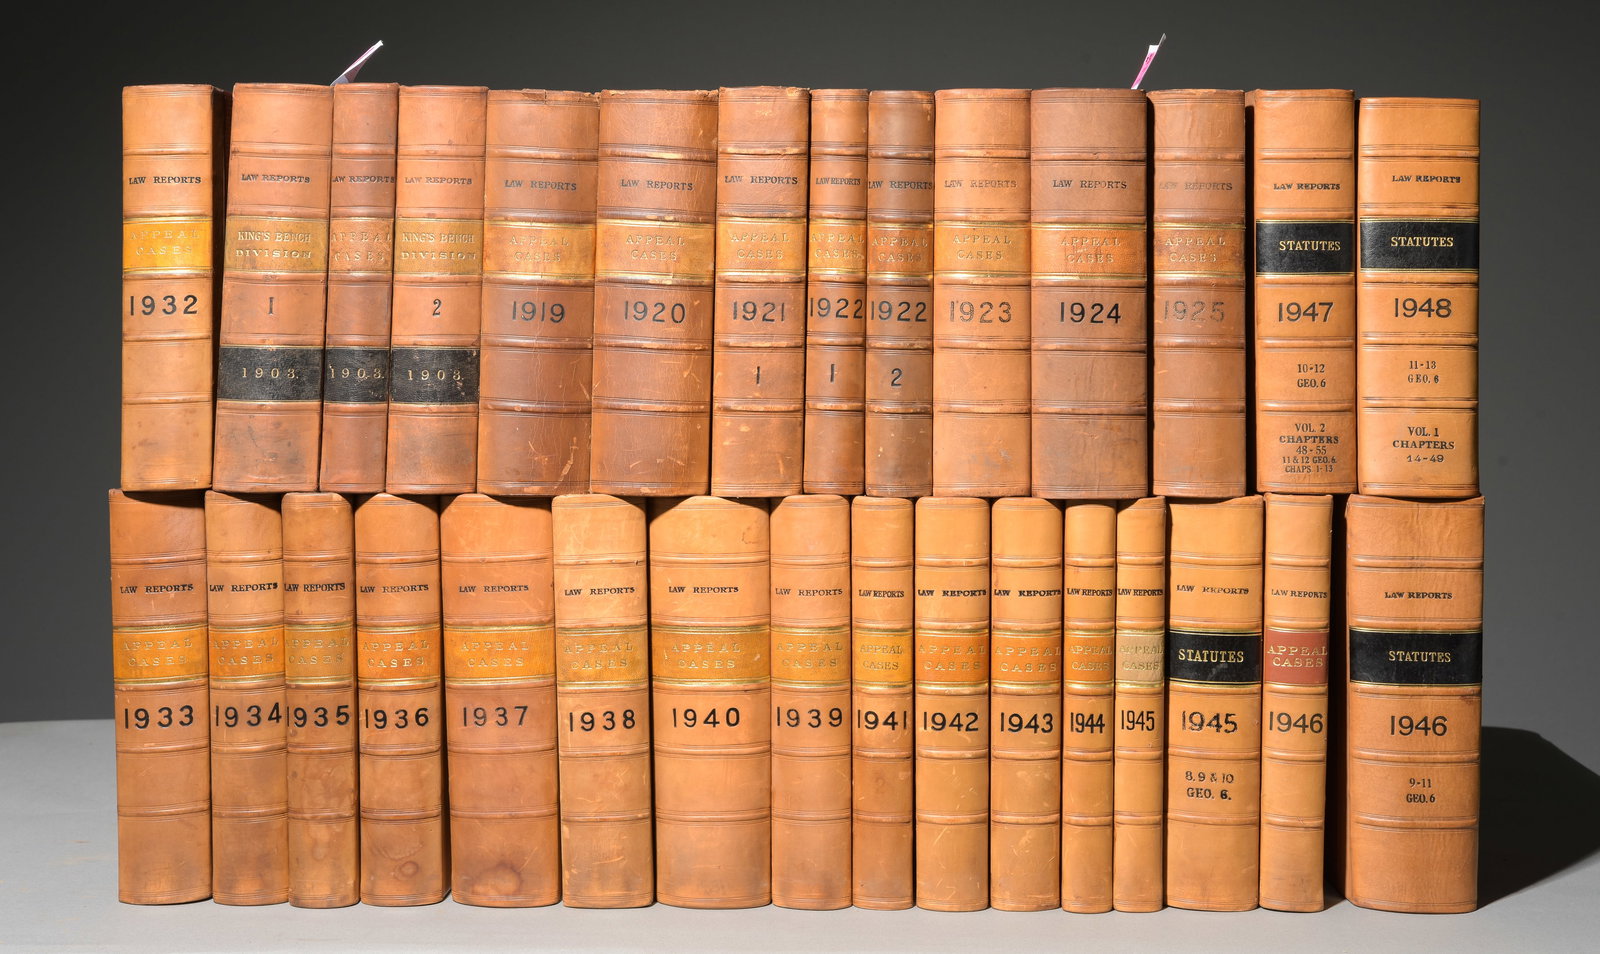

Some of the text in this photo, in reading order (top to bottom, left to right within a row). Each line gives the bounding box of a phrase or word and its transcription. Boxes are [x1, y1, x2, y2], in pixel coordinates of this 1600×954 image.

[153, 176, 202, 184] REPORTS
[262, 175, 311, 183] REPORTS
[425, 177, 472, 185] REPORTS
[751, 176, 798, 185] REPORTS
[831, 178, 861, 186] REPORTS
[944, 180, 1017, 188] LAW REPORTS
[1416, 175, 1461, 183] REPORTS
[504, 180, 577, 190] LAW REPORTS
[621, 179, 693, 190] LAW REPORTS
[868, 181, 933, 190] LAW REPORTS
[1052, 180, 1128, 190] LAW REPORTS
[238, 232, 312, 242] KING'S BENCH
[402, 233, 475, 243] KING'S BENCH
[626, 235, 685, 245] APPEAL
[731, 233, 790, 242] APPEAL
[953, 234, 1012, 245] APPEAL
[1166, 237, 1226, 246] APPEAL
[1391, 237, 1454, 247] STATUTES
[1279, 240, 1341, 251] STATUTES
[236, 250, 312, 258] DIVISION
[402, 252, 476, 260] DIVISION
[631, 250, 677, 261] CASES
[737, 250, 783, 259] CASES
[957, 250, 1003, 260] CASES
[130, 295, 198, 316] 1932
[432, 299, 442, 316] 2
[810, 298, 863, 319] 1922
[1394, 298, 1452, 318] 1948
[512, 301, 565, 323] 1919
[625, 301, 686, 323] 1920
[733, 302, 785, 322] 1921
[872, 301, 927, 322] 1922
[950, 301, 1012, 324] 1923
[1060, 302, 1121, 324] 1924
[1164, 300, 1224, 323] 1925
[1278, 302, 1334, 322] 1947
[1297, 364, 1325, 373] 10-12
[1409, 361, 1437, 369] 11-13
[891, 368, 903, 387] 2
[1408, 375, 1431, 384] GEO.
[1297, 379, 1326, 388] GEO. 6
[1295, 424, 1325, 433] VOL. 2
[1408, 427, 1439, 437] VOL. 1
[1279, 436, 1339, 444] CHAPTERS
[1392, 440, 1455, 450] CHAPTERS
[1283, 456, 1292, 464] 11
[1293, 456, 1299, 464] &
[1301, 456, 1310, 464] 12
[120, 584, 194, 594] LAW REPORTS
[209, 582, 279, 592] LAW REPORTS
[285, 583, 346, 592] LAW REPORTS
[382, 585, 429, 593] REPORTS
[590, 587, 635, 595] REPORTS
[693, 586, 739, 594] REPORTS
[1117, 588, 1163, 596] LAW REPORTS
[1202, 587, 1249, 595] REPORTS
[799, 589, 843, 597] REPORTS
[859, 589, 905, 598] LAW REPORTS
[918, 589, 987, 597] LAW REPORTS
[1019, 589, 1062, 597] REPORTS
[1290, 590, 1328, 599] REPORTS
[1408, 592, 1452, 600] REPORTS
[672, 643, 741, 653] APPEAL
[860, 644, 903, 655] APPEAL
[1267, 645, 1328, 656] APPEAL
[1179, 649, 1244, 663] STATUTES
[1389, 651, 1451, 663] STATUTES
[679, 660, 736, 669] CASES
[863, 662, 899, 671] CASES
[924, 661, 981, 671] CASES
[1273, 657, 1324, 668] CASES
[1001, 663, 1057, 673] CASES
[124, 705, 194, 729] 1933
[215, 702, 282, 728] 1934
[287, 705, 349, 728] 1935
[365, 708, 429, 729] 1936
[463, 706, 528, 727] 1937
[672, 708, 740, 728] 1940
[776, 707, 843, 728] 1939
[857, 709, 907, 731] 1941
[569, 709, 636, 732] 1938
[924, 712, 979, 732] 1942
[1001, 712, 1054, 734] 1943
[1070, 712, 1105, 734] 1944
[1121, 710, 1155, 731] 1945
[1182, 711, 1238, 734] 1945
[1269, 711, 1323, 734] 1946
[1390, 715, 1448, 737] 1946
[1198, 772, 1206, 782] 9
[1210, 773, 1217, 782] &
[1409, 778, 1432, 788] 9-11
[1187, 788, 1215, 799] GEO.
[1406, 794, 1436, 804] GEO. 6
